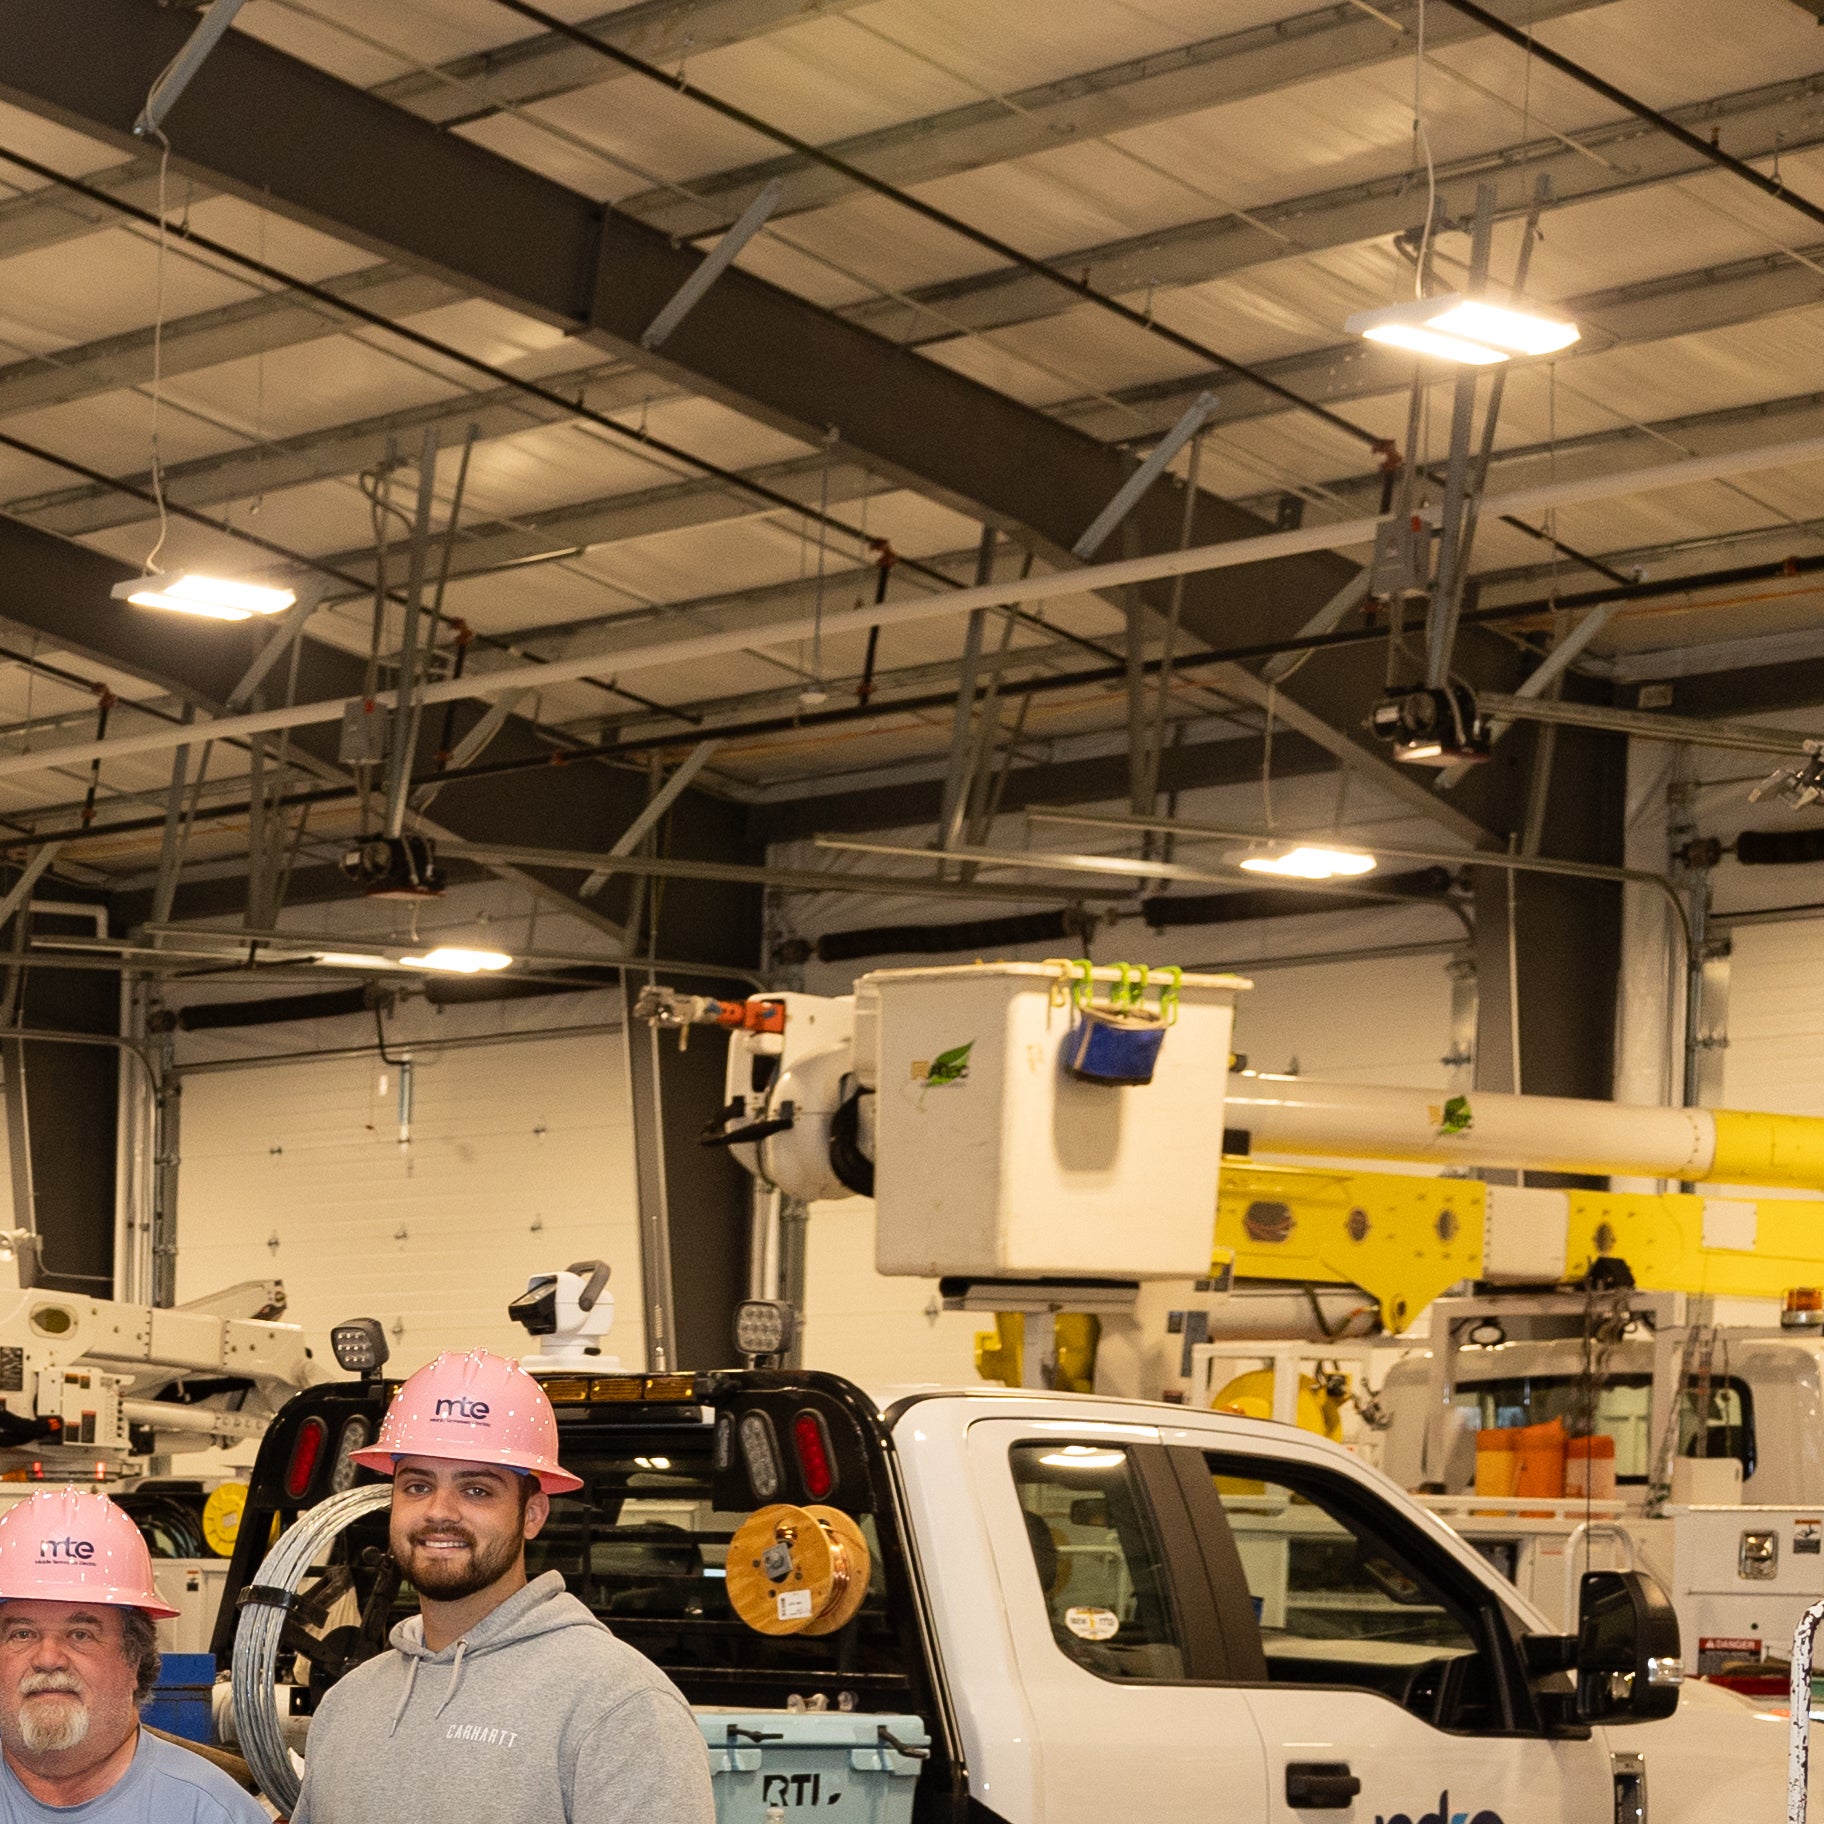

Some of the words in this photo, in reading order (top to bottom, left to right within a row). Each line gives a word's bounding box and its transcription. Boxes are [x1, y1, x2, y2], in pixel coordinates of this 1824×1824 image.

[435, 1396, 490, 1420] mte
[40, 1536, 95, 1560] mte
[446, 1724, 518, 1748] CARHARTT
